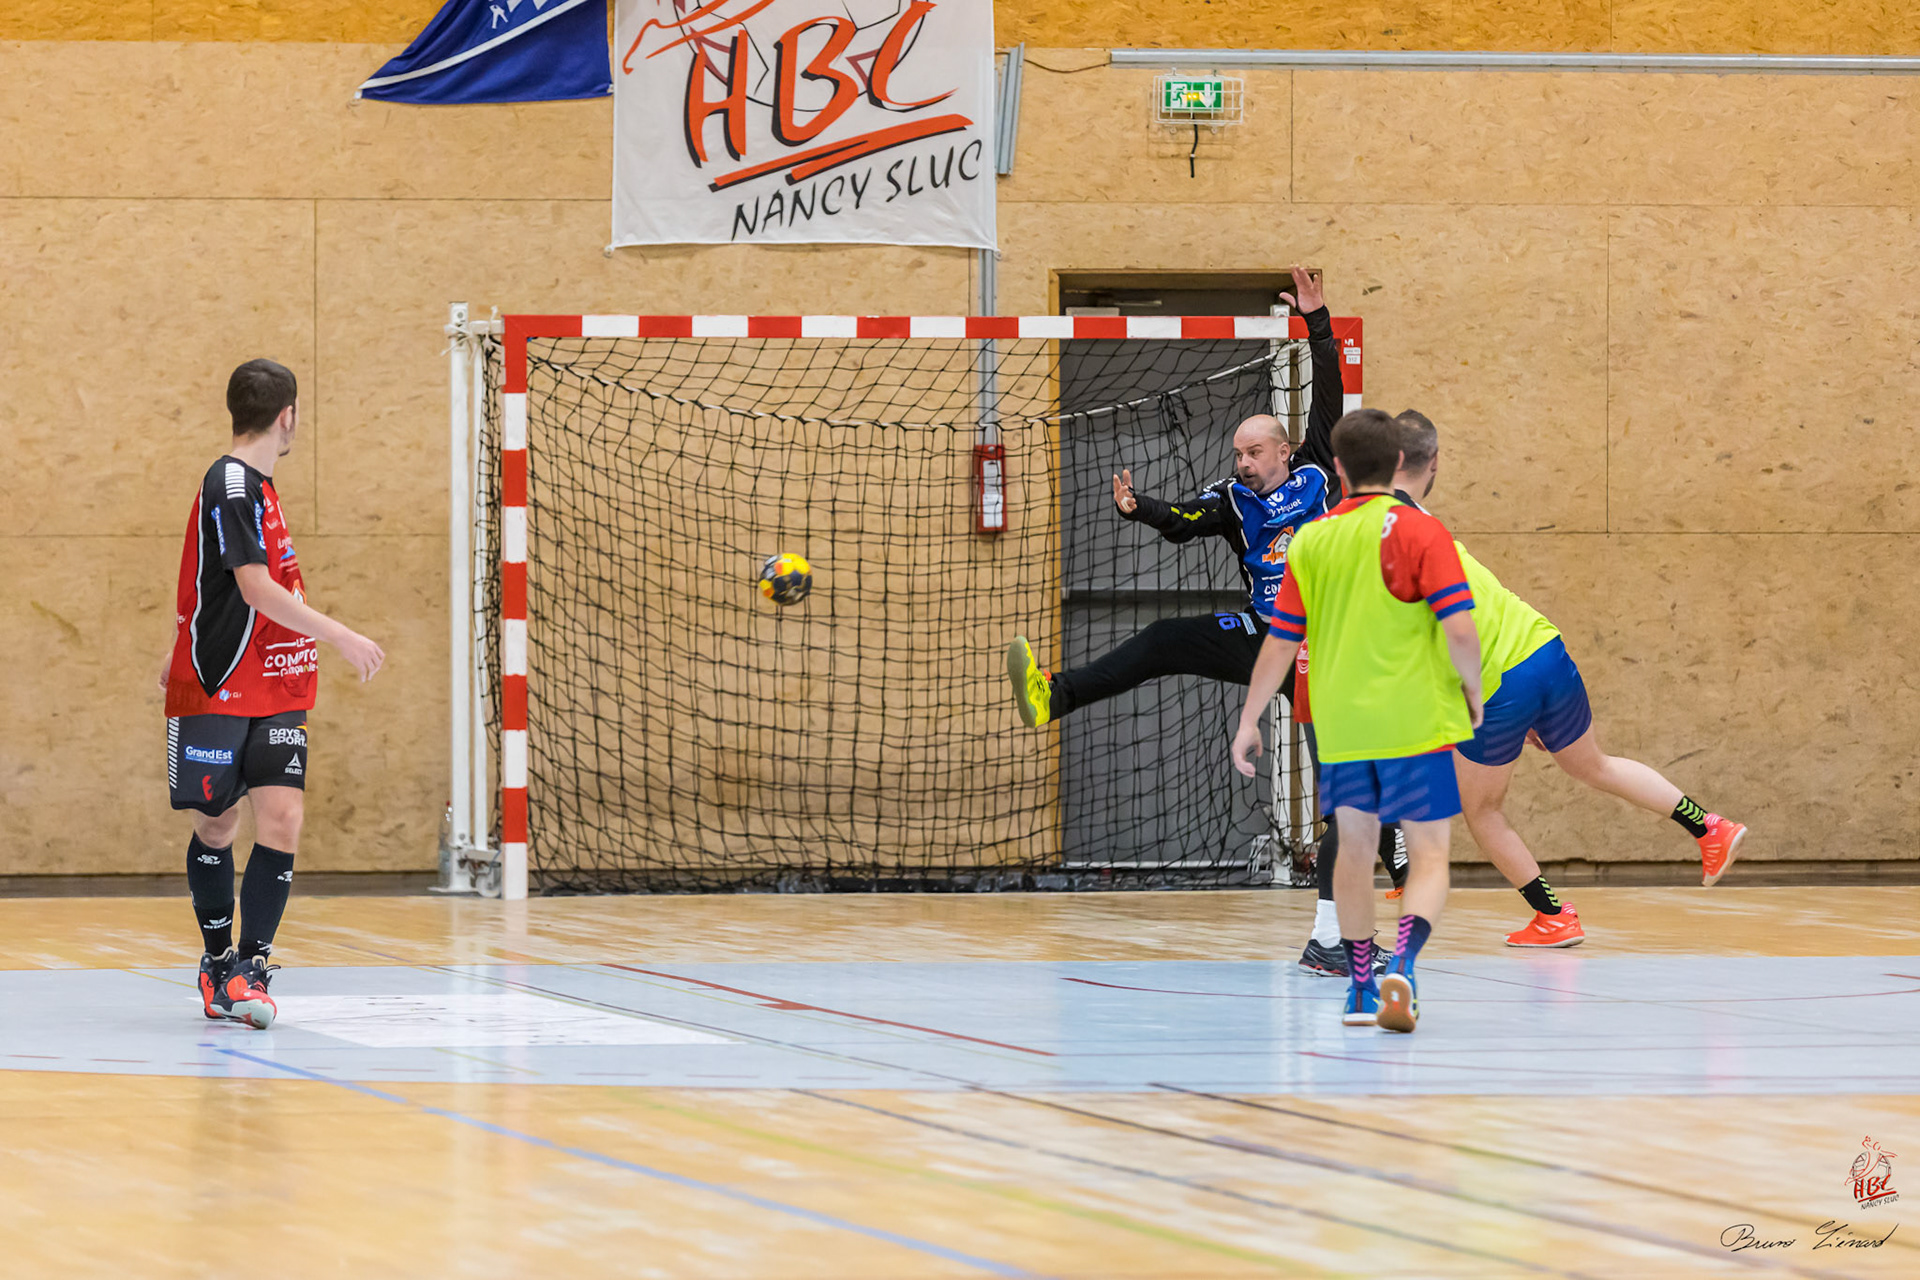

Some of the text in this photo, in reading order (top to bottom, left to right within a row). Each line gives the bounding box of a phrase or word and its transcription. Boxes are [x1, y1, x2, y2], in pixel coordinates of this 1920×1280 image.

[683, 1, 959, 168] HBC
[731, 139, 983, 241] NANCY SLUC
[296, 637, 305, 648] LE
[269, 728, 300, 737] PAYS
[185, 746, 214, 760] Grand
[215, 750, 233, 760] Est
